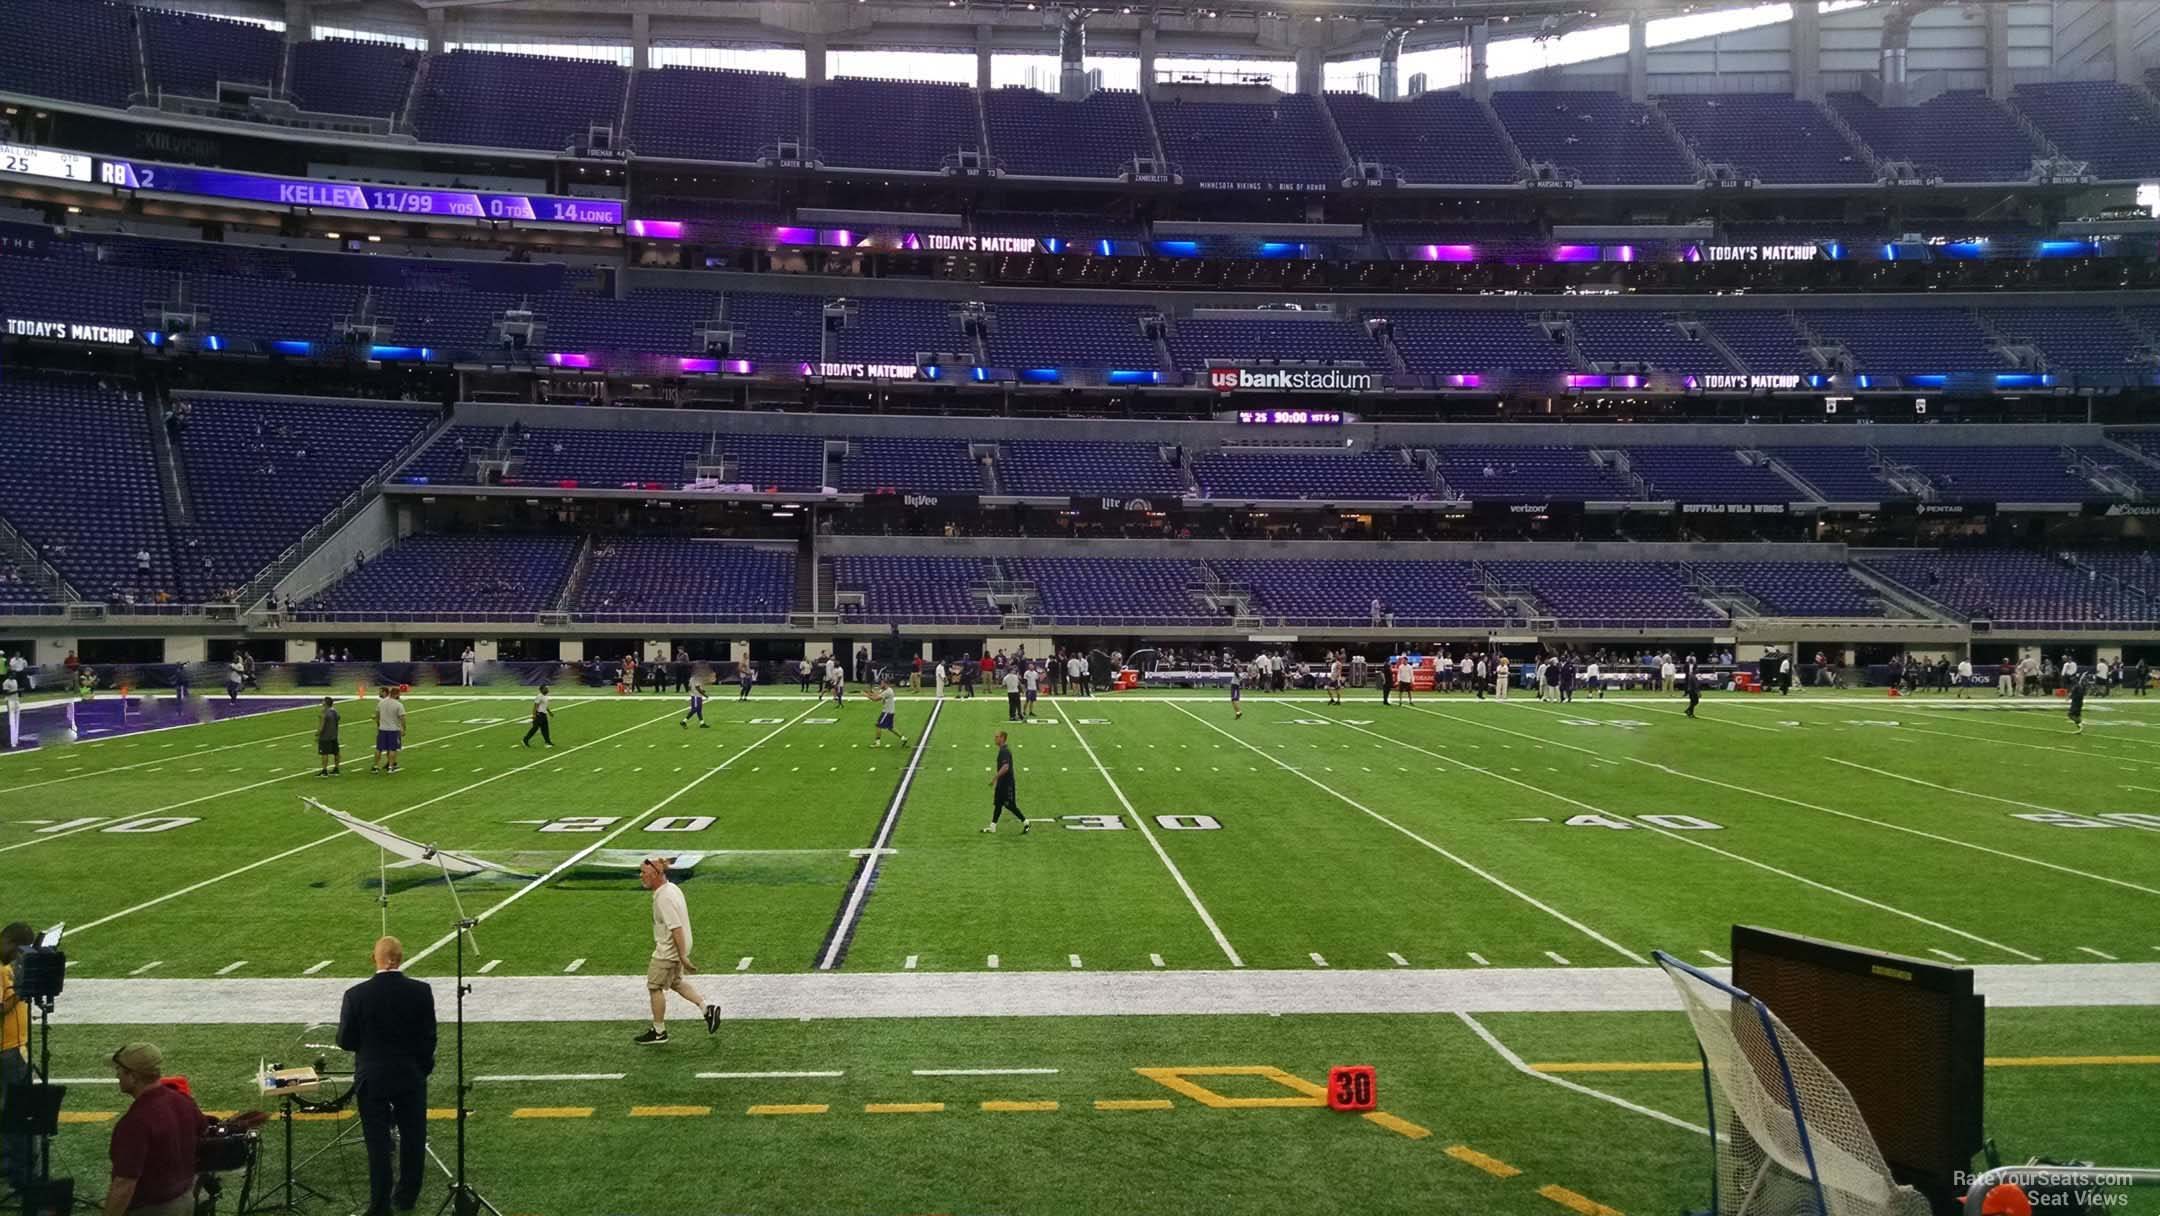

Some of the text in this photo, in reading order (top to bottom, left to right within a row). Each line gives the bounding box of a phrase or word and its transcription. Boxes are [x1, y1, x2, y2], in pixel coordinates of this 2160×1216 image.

[6, 156, 29, 171] 25
[65, 164, 75, 177] 1
[102, 162, 154, 187] RB 2
[280, 184, 613, 223] KELLEY 11/99 YDS 0 TDS 14 LONG
[2, 237, 35, 249] THE
[928, 234, 1037, 254] TODAY'S MATCHUP
[1708, 245, 1818, 261] TODAY'S MATCHUP
[7, 318, 135, 344] TODAY'S MATCHUP
[819, 362, 917, 380] TODAY'S MATCHUP
[1704, 374, 1800, 390] TODAY'S MATCHUP
[1254, 413, 1268, 423] 25
[1510, 504, 1546, 513] verizon
[1682, 504, 1785, 513] BUFFALO WILD WINGS
[1926, 505, 1963, 513] PENTAIR
[1336, 1071, 1371, 1106] 30
